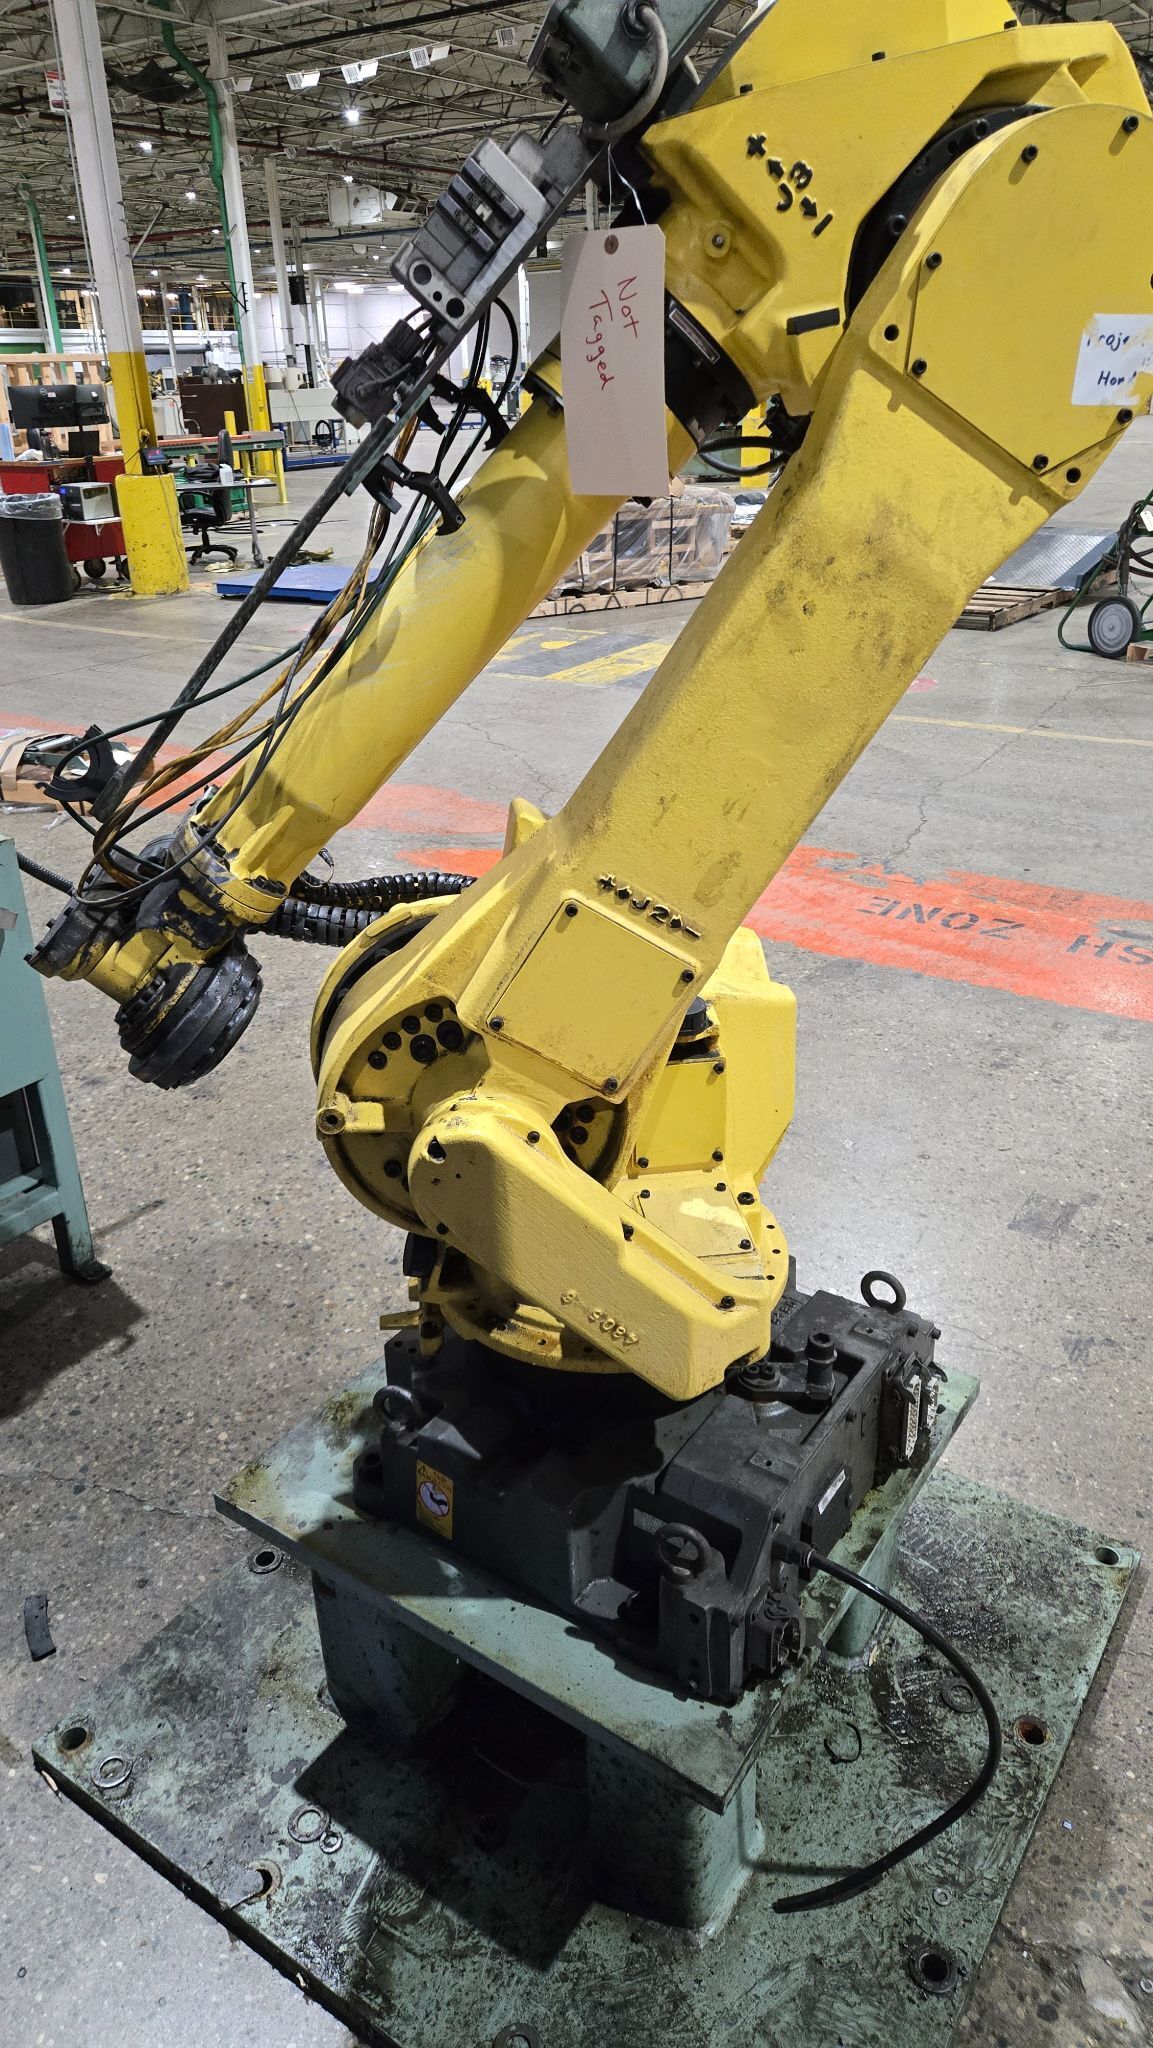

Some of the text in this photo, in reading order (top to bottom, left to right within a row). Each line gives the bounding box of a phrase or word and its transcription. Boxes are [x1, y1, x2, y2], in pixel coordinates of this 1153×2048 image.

[618, 276, 639, 338] Not
[584, 289, 615, 390] Tagged
[856, 896, 1025, 940] ZONE
